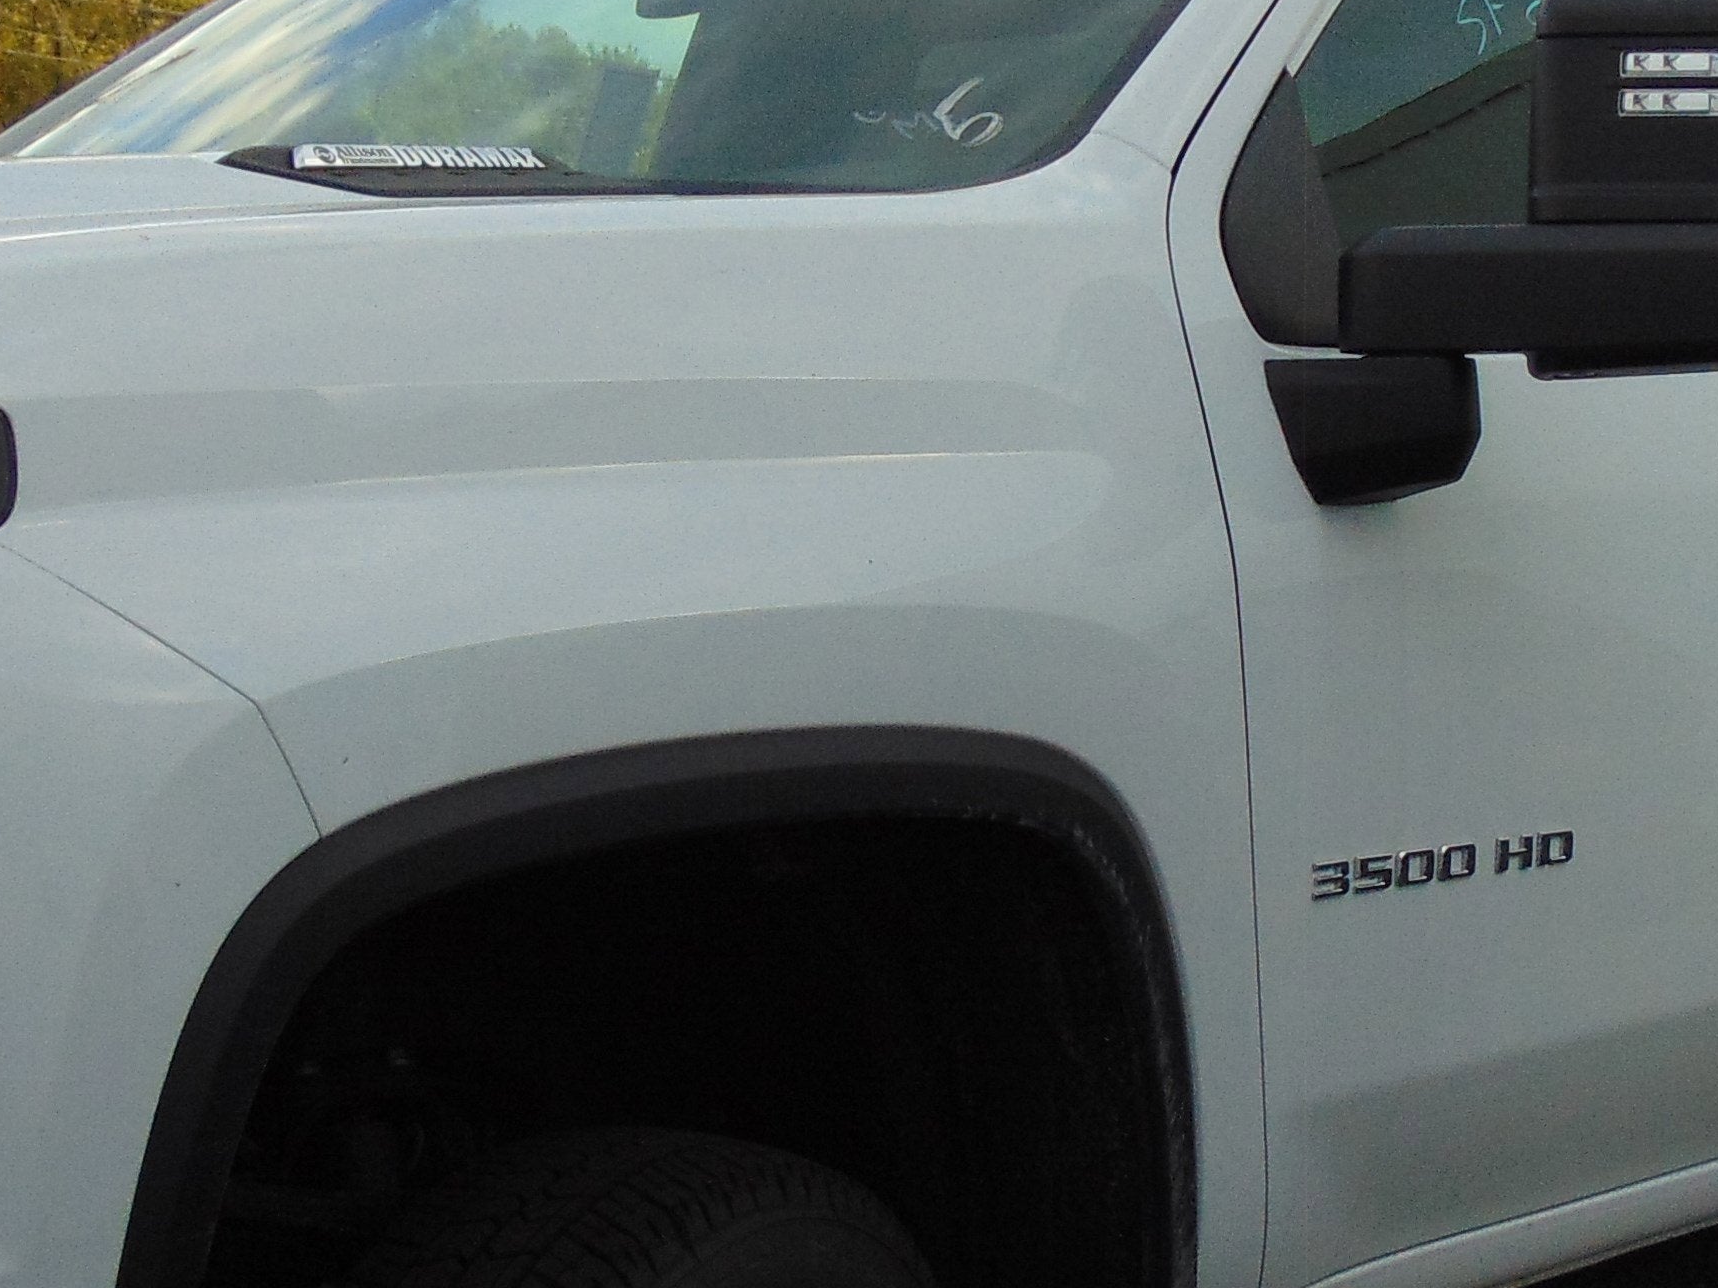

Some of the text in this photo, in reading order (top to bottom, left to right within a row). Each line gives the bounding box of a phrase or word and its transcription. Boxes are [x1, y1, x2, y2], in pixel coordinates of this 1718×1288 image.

[394, 144, 546, 169] DURAMAX
[1311, 830, 1574, 901] 3500 HD
